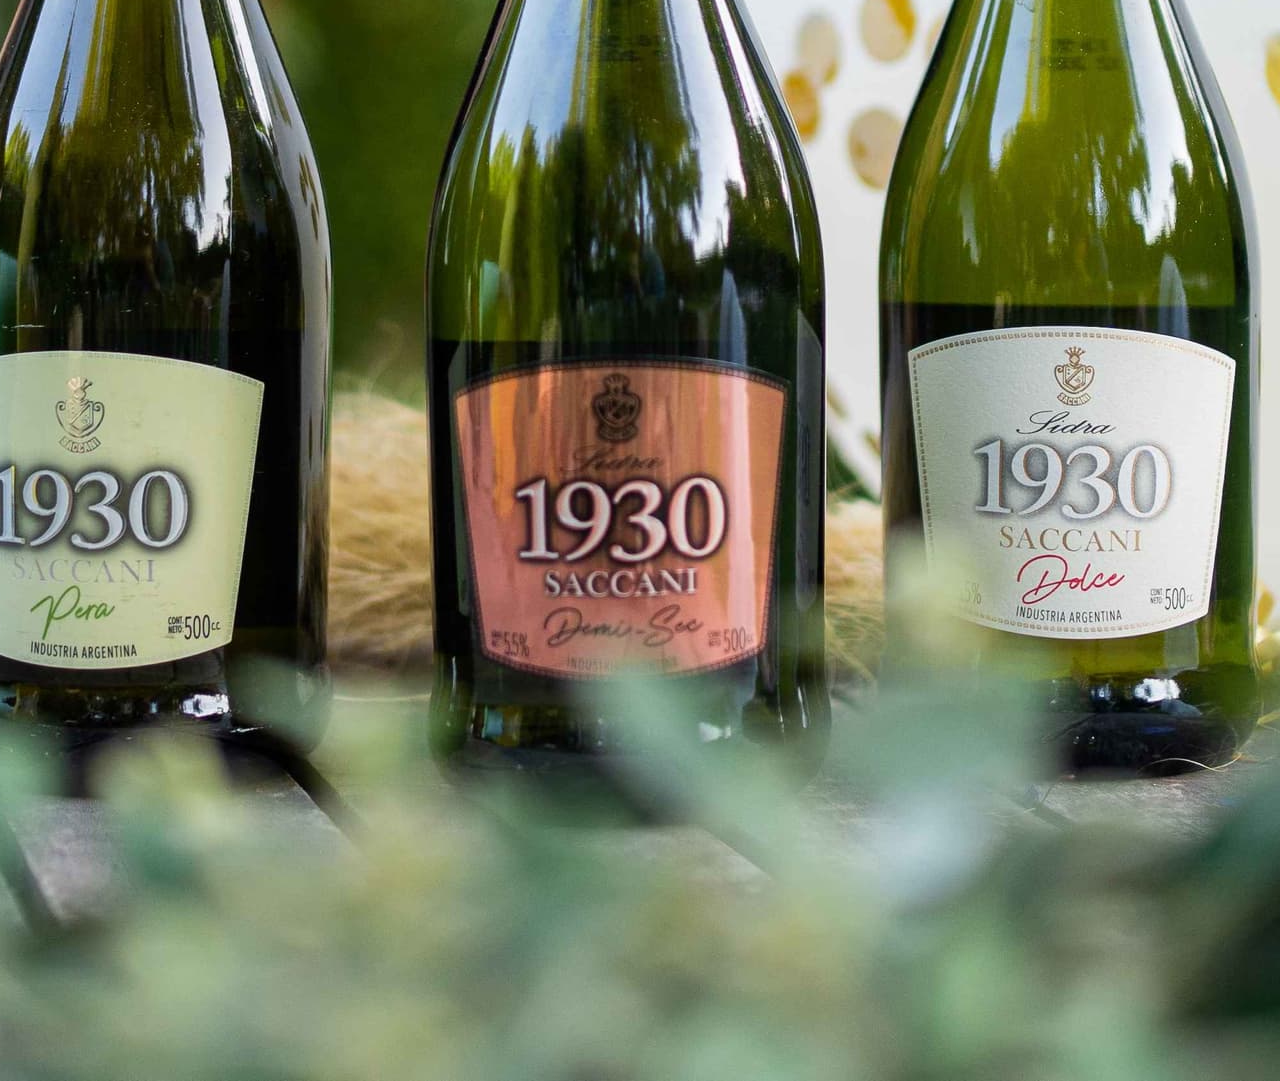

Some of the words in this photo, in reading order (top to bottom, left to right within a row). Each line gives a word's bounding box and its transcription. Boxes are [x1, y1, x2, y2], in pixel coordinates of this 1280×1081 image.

[1016, 410, 1117, 435] Sidra
[973, 438, 1172, 521] 1930
[514, 475, 728, 563] 1930
[998, 524, 1142, 552] SACCANI
[13, 554, 157, 584] SACCANI
[543, 567, 697, 598] SACCANI
[1016, 554, 1126, 605] Dolce
[1164, 586, 1186, 610] 500
[30, 585, 116, 641] Pera
[184, 614, 211, 640] 500
[1016, 605, 1067, 622] INDUSTRIA
[1068, 609, 1123, 624] ARGENTINA
[30, 640, 79, 658] INDUSTRIA
[81, 644, 138, 659] ARGENTINA
[723, 626, 746, 654] 500
